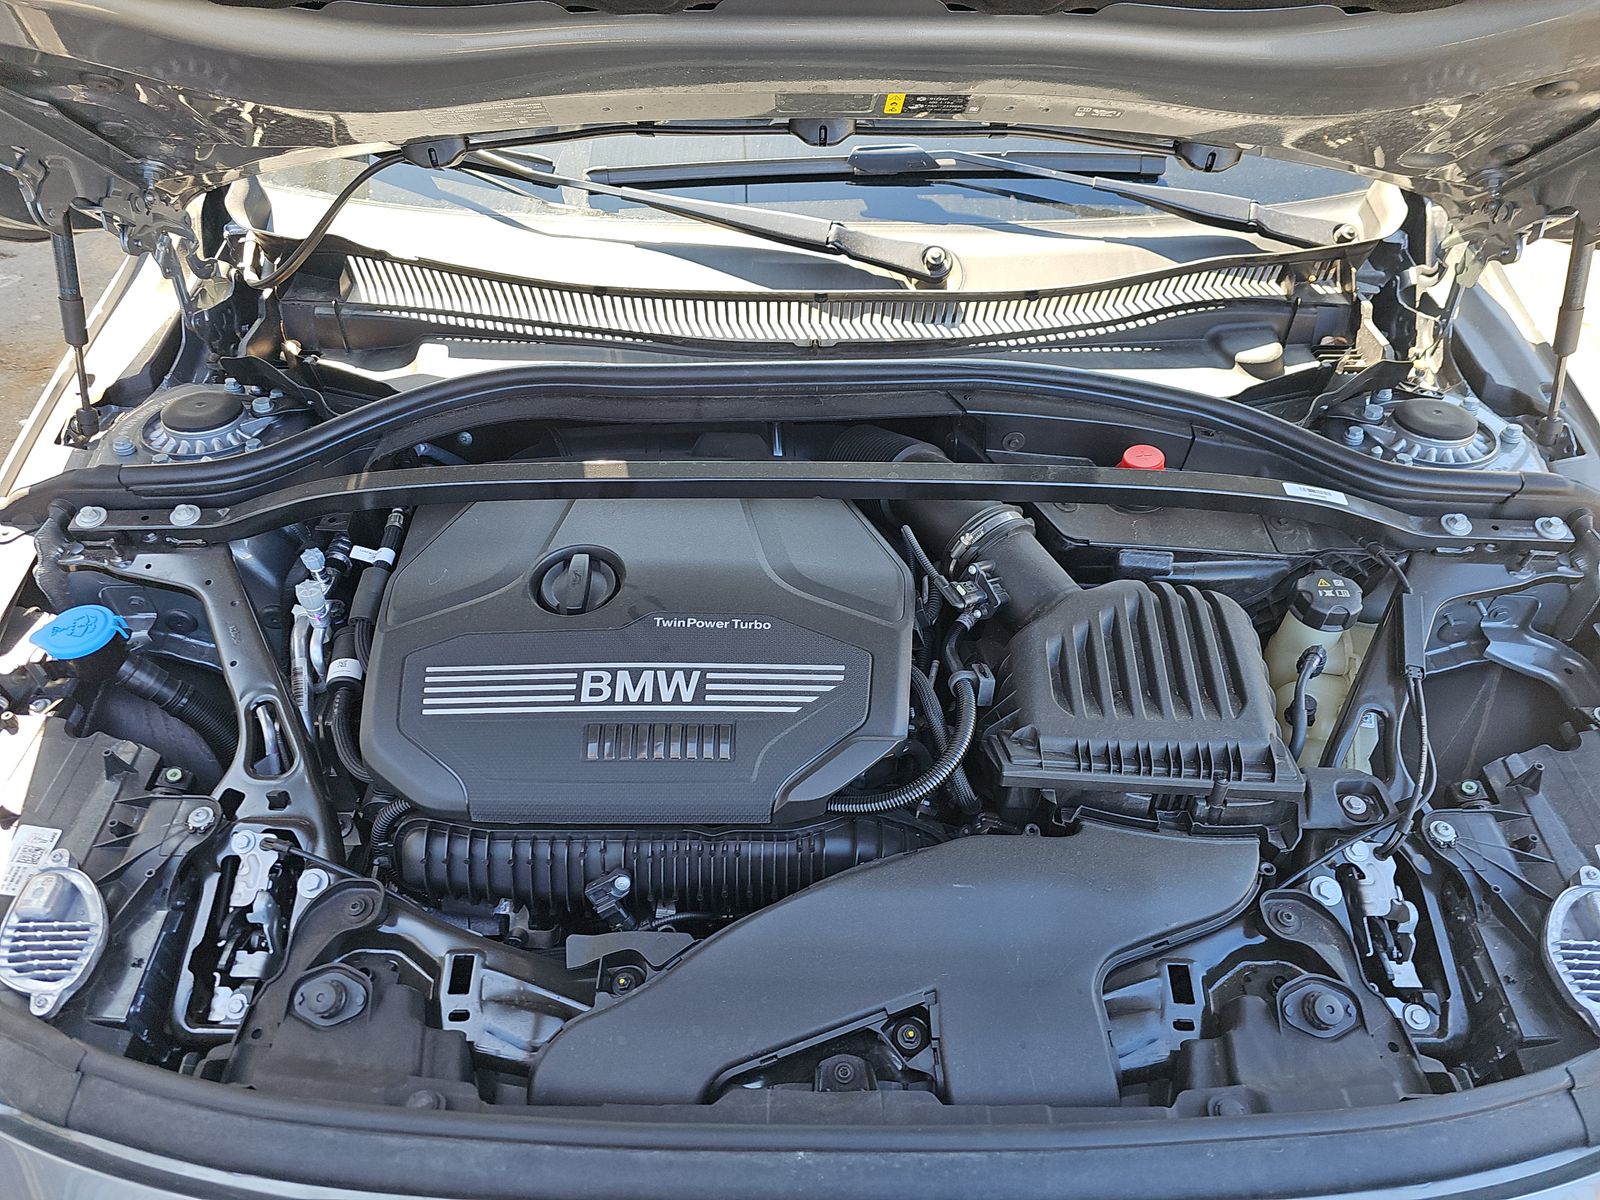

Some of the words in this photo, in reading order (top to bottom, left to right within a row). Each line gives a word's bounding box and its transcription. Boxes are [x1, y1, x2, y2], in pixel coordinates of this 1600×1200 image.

[653, 616, 730, 630] TwinPower
[731, 618, 772, 631] Turbo
[579, 669, 702, 704] BMW
